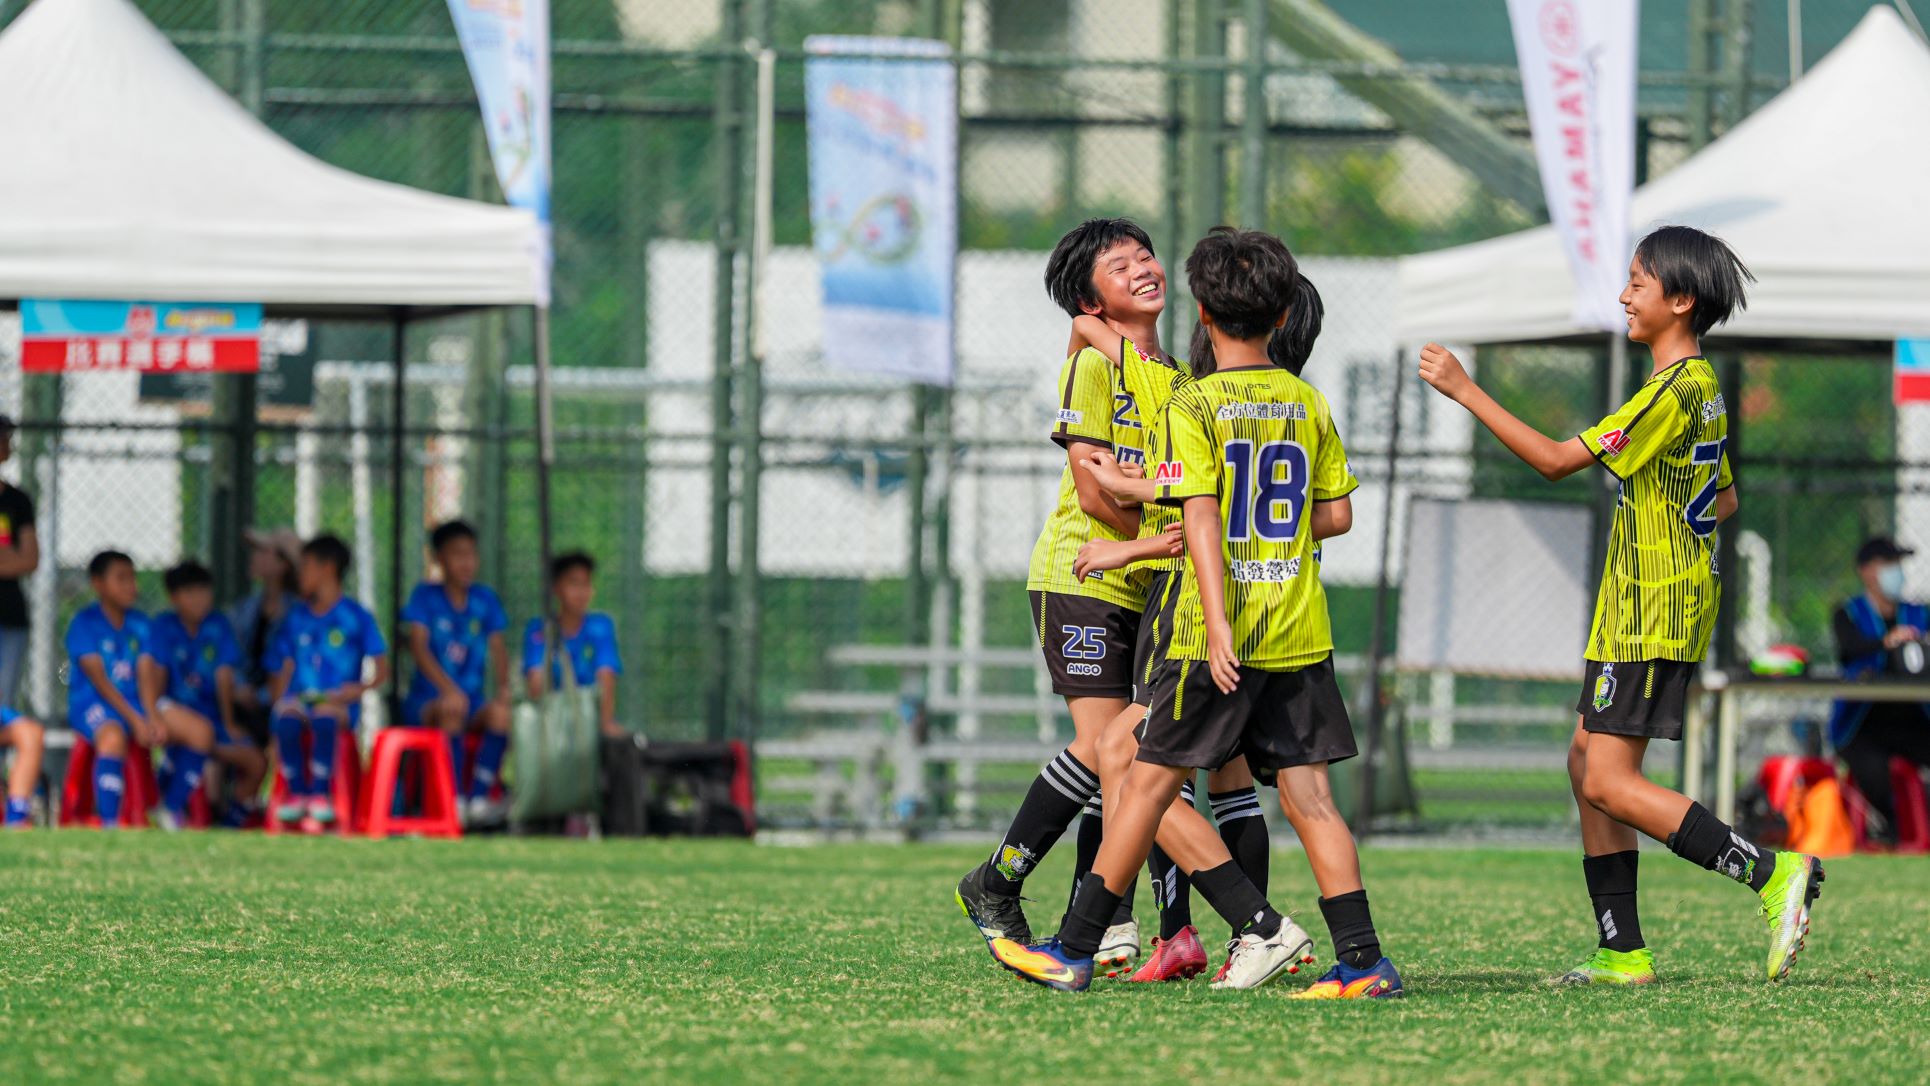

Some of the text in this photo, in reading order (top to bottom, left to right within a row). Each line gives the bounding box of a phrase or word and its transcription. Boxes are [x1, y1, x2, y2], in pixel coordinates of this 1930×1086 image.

[1225, 439, 1310, 543] 18
[1062, 625, 1106, 659] 25
[1067, 663, 1101, 676] ANGO
